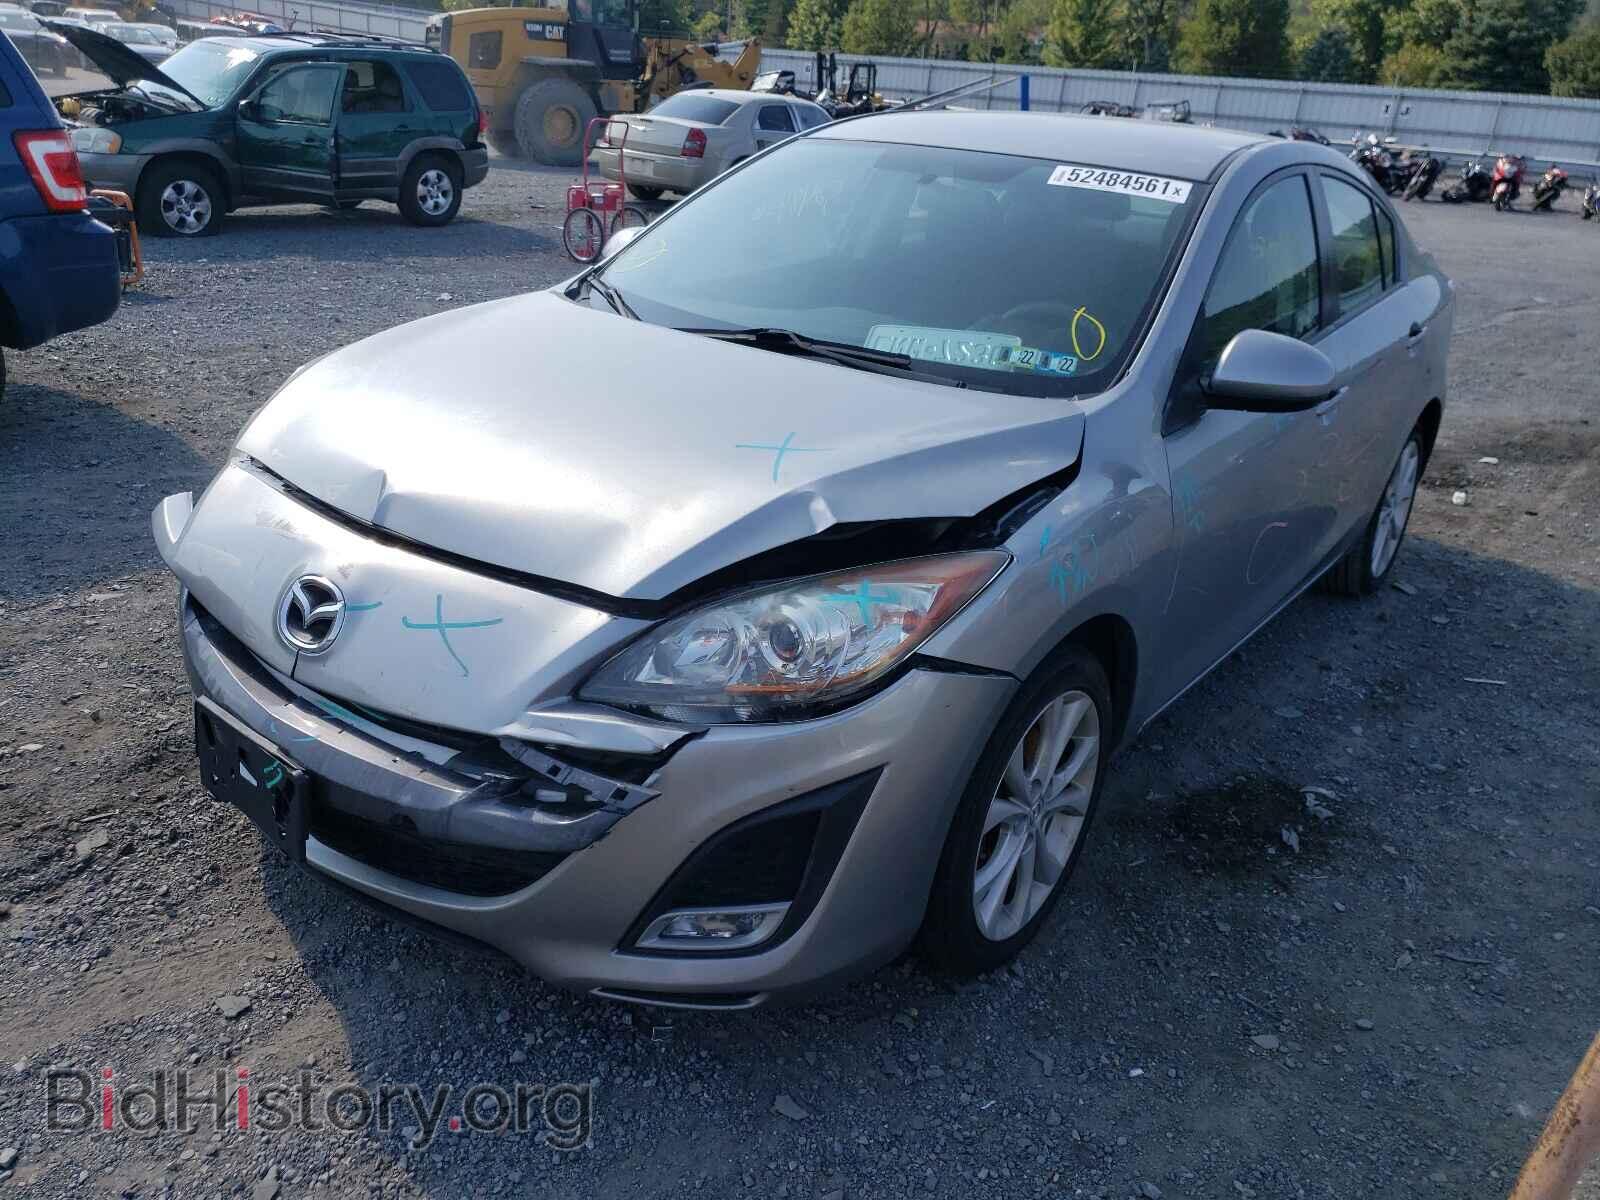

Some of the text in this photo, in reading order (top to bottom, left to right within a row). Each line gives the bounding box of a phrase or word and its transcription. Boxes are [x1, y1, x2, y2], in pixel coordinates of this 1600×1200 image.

[545, 24, 565, 40] CAT
[1066, 168, 1171, 195] 52484561
[1060, 357, 1074, 372] 22
